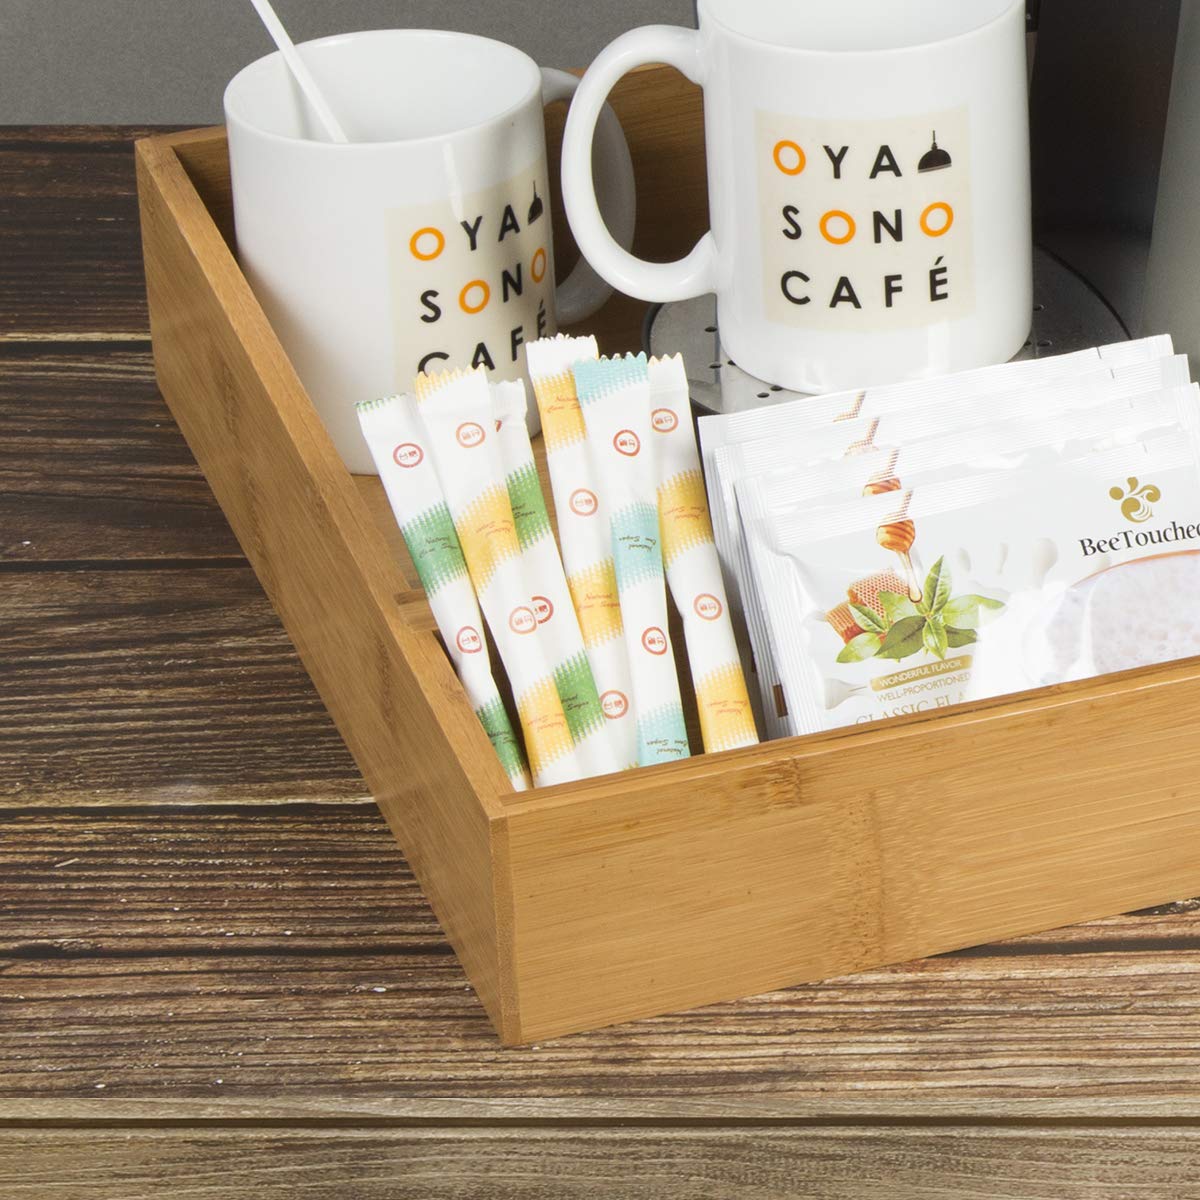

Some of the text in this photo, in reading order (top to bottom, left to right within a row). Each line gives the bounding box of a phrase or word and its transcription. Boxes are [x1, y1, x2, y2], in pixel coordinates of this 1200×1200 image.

[773, 140, 903, 179] OYA
[409, 204, 521, 262] OYA
[781, 201, 955, 245] SONO
[420, 247, 547, 323] SONO
[780, 255, 949, 309] CAFÉ
[879, 665, 930, 687] WONDERFUL
